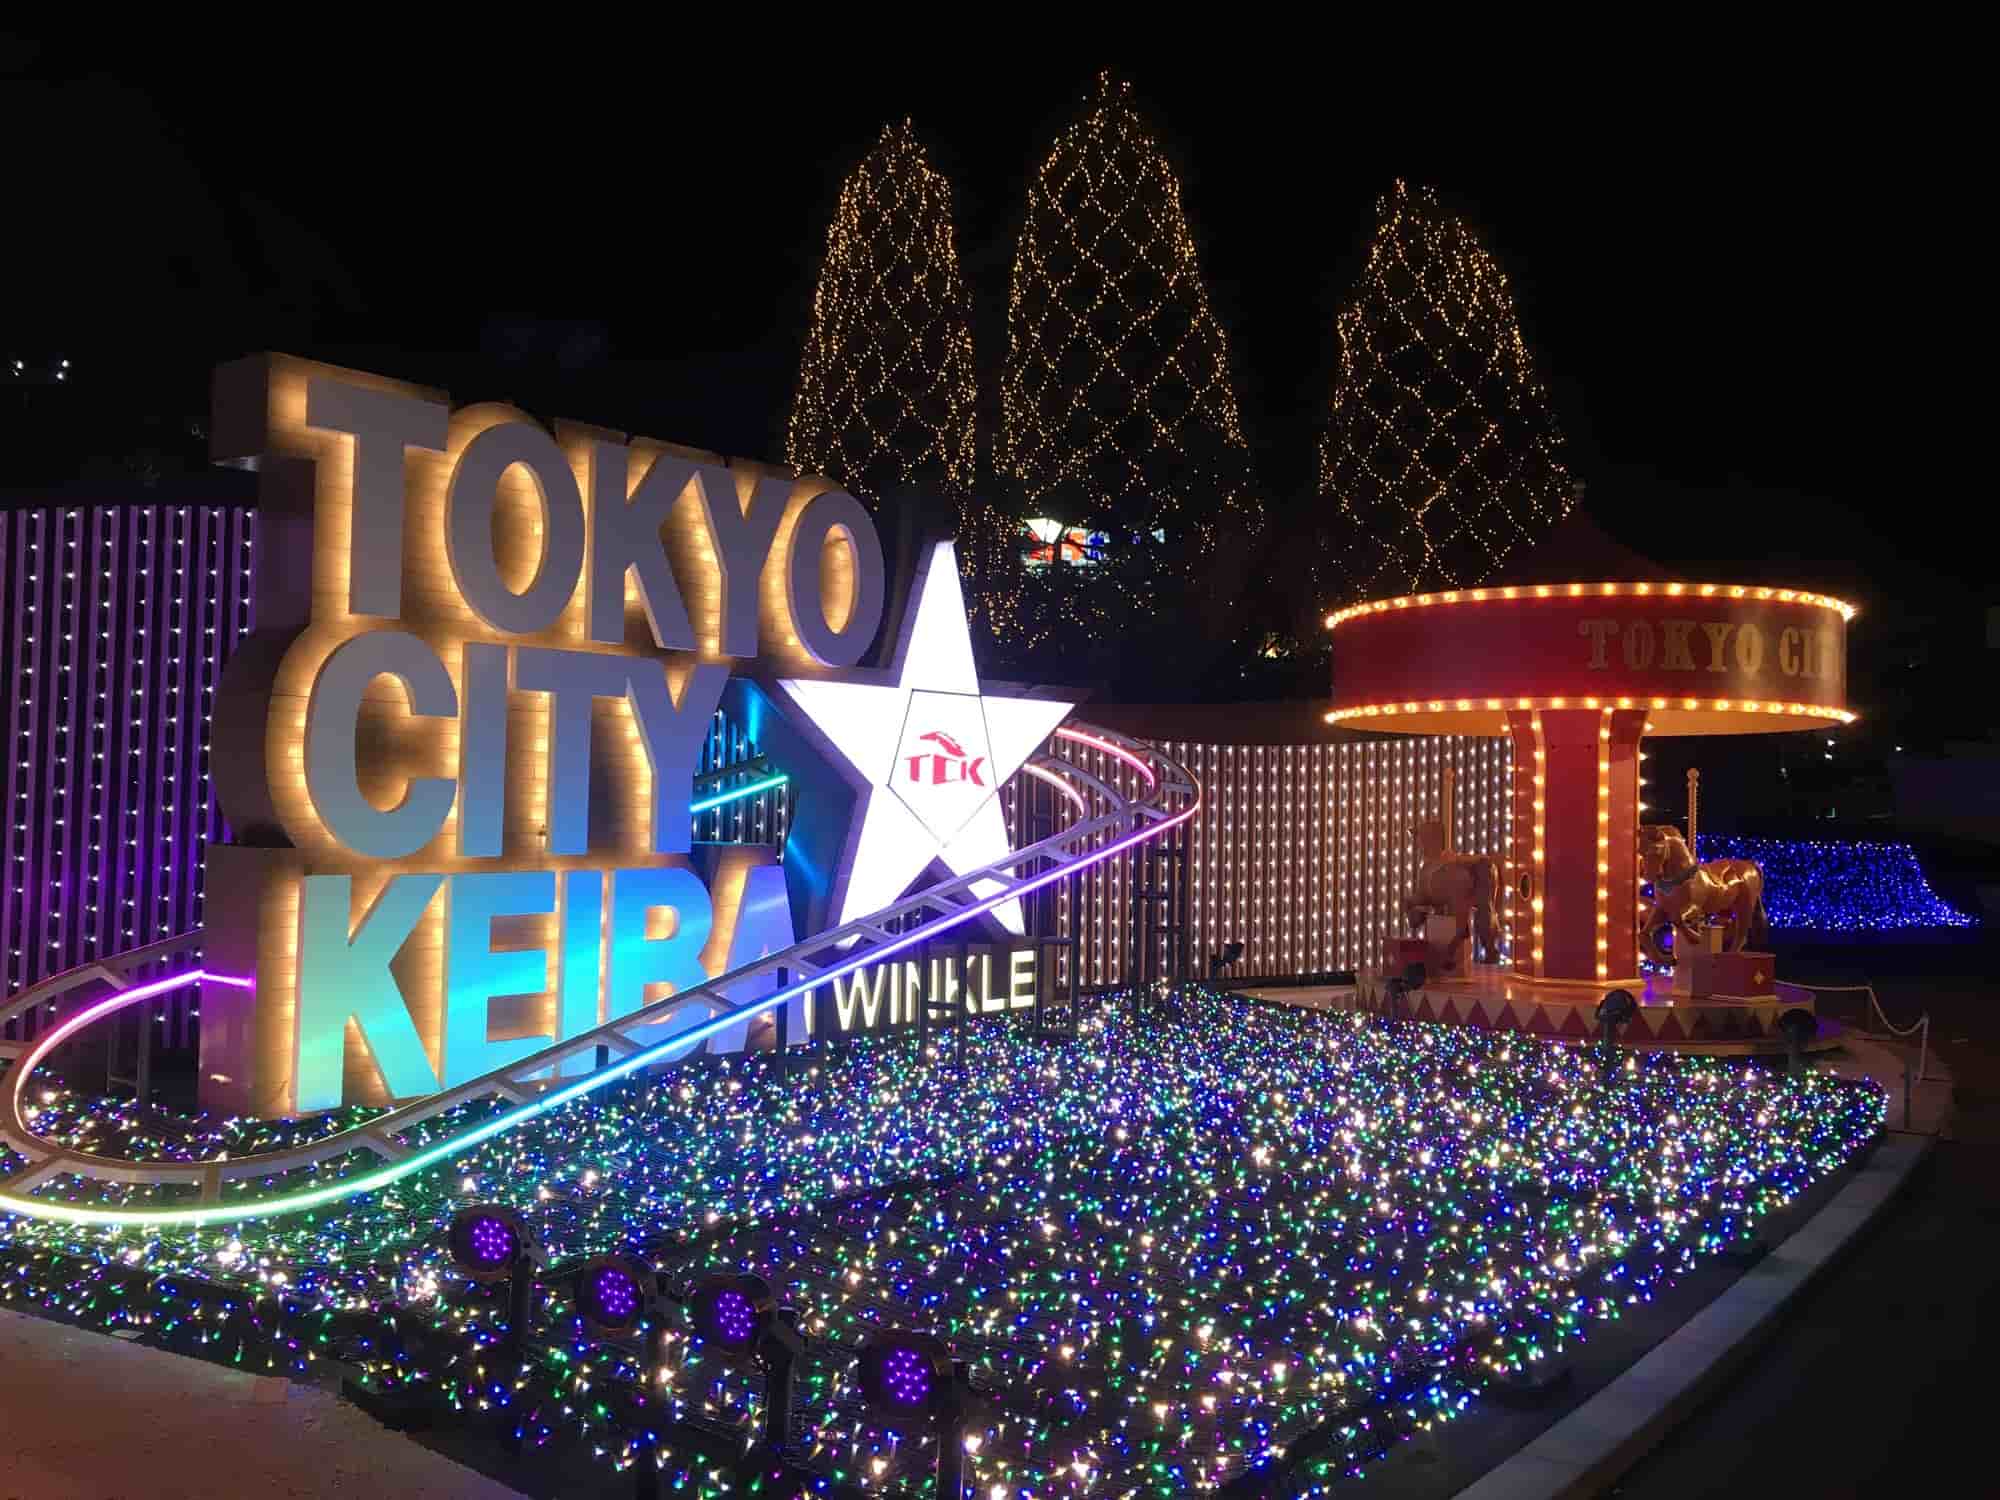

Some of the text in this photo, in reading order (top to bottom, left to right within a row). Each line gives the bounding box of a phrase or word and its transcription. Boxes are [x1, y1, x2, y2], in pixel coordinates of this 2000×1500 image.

[305, 376, 886, 669] TOKYO
[303, 629, 732, 858] CITY
[1578, 618, 1838, 679] TOKYO CI
[296, 864, 810, 1113] KEIBA
